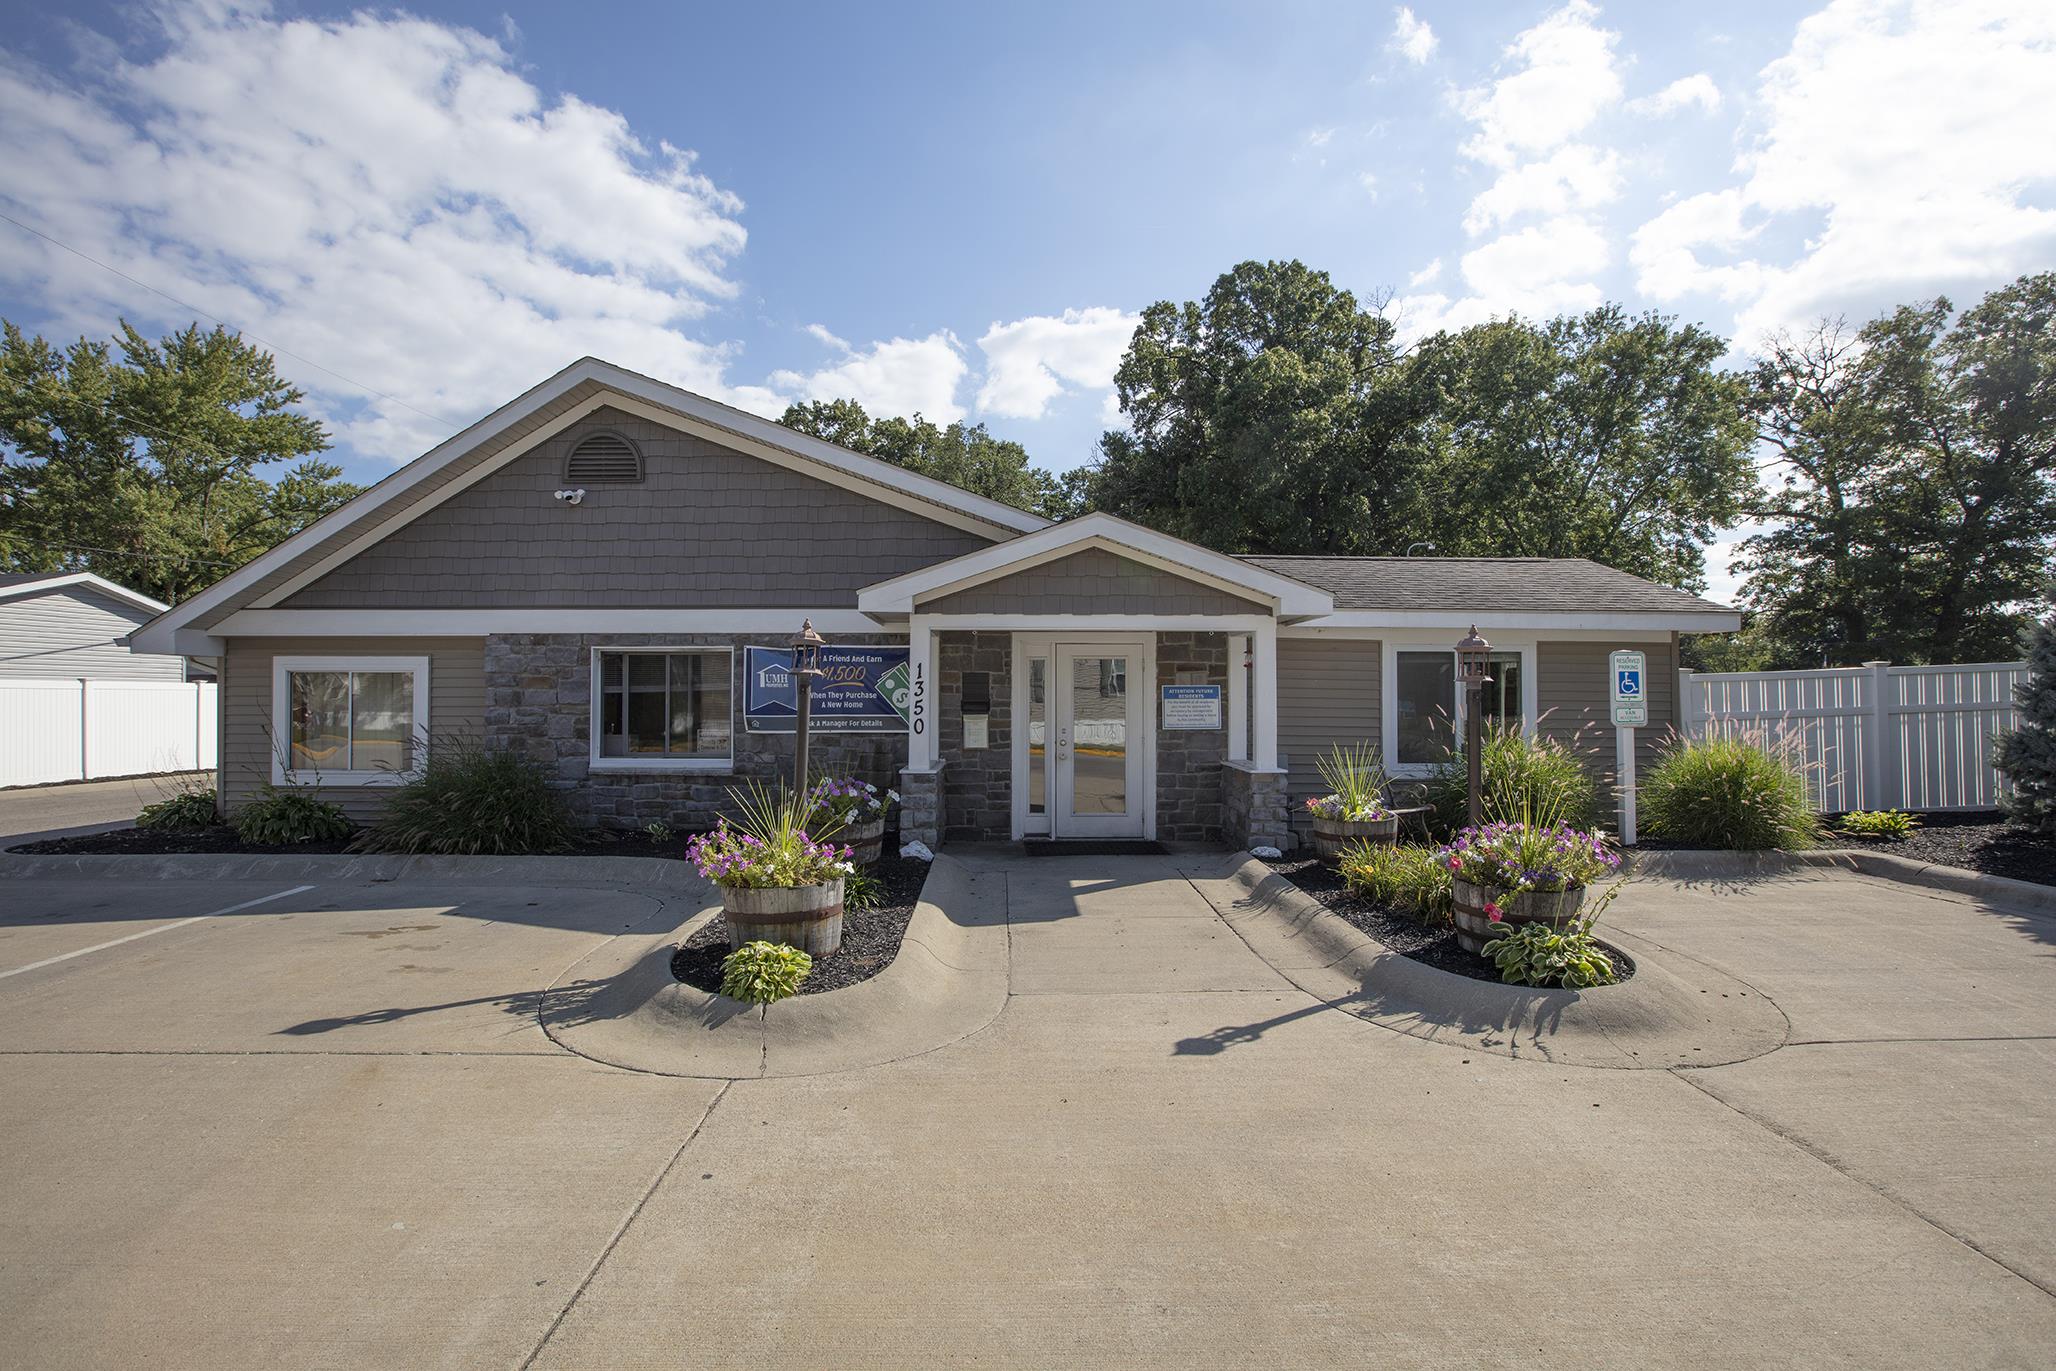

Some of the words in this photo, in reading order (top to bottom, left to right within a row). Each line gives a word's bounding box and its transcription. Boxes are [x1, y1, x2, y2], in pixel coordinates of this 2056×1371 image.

[766, 674, 788, 683] UMH
[828, 692, 843, 700] They
[914, 662, 924, 734] 1350
[821, 720, 848, 728] Manager
